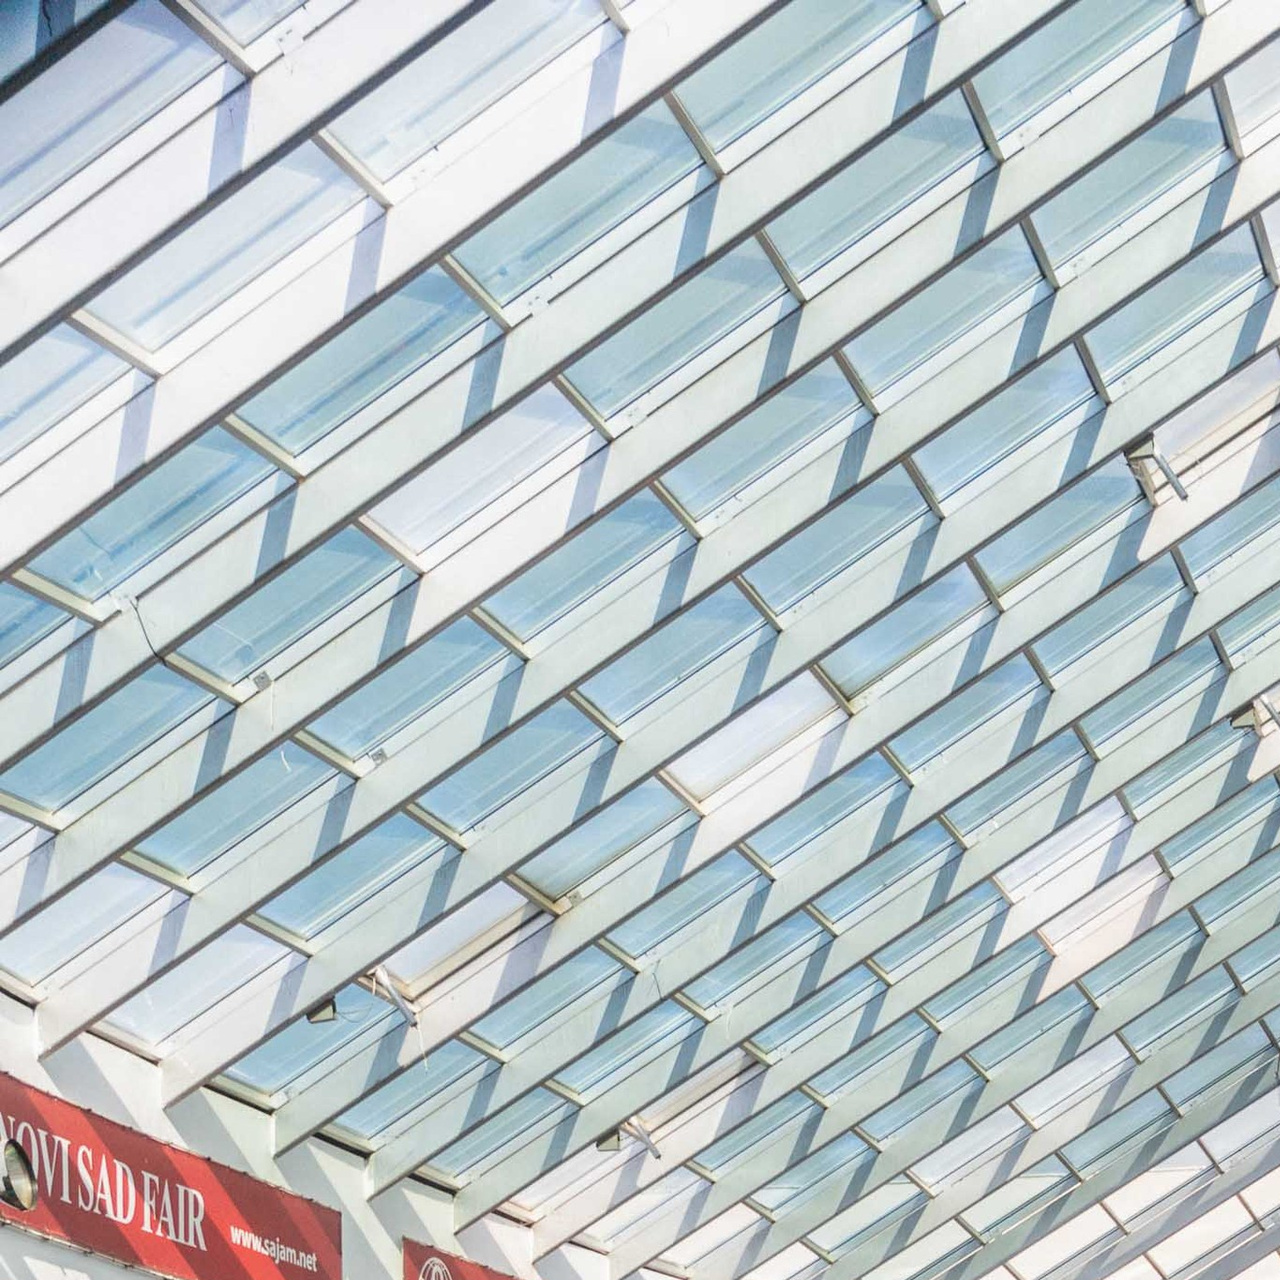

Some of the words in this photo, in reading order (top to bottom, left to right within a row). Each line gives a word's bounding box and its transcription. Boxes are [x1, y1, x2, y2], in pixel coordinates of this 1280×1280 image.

[77, 1145, 136, 1225] SAD
[141, 1170, 208, 1251] FAIR
[230, 1225, 318, 1272] www.sajam.net
